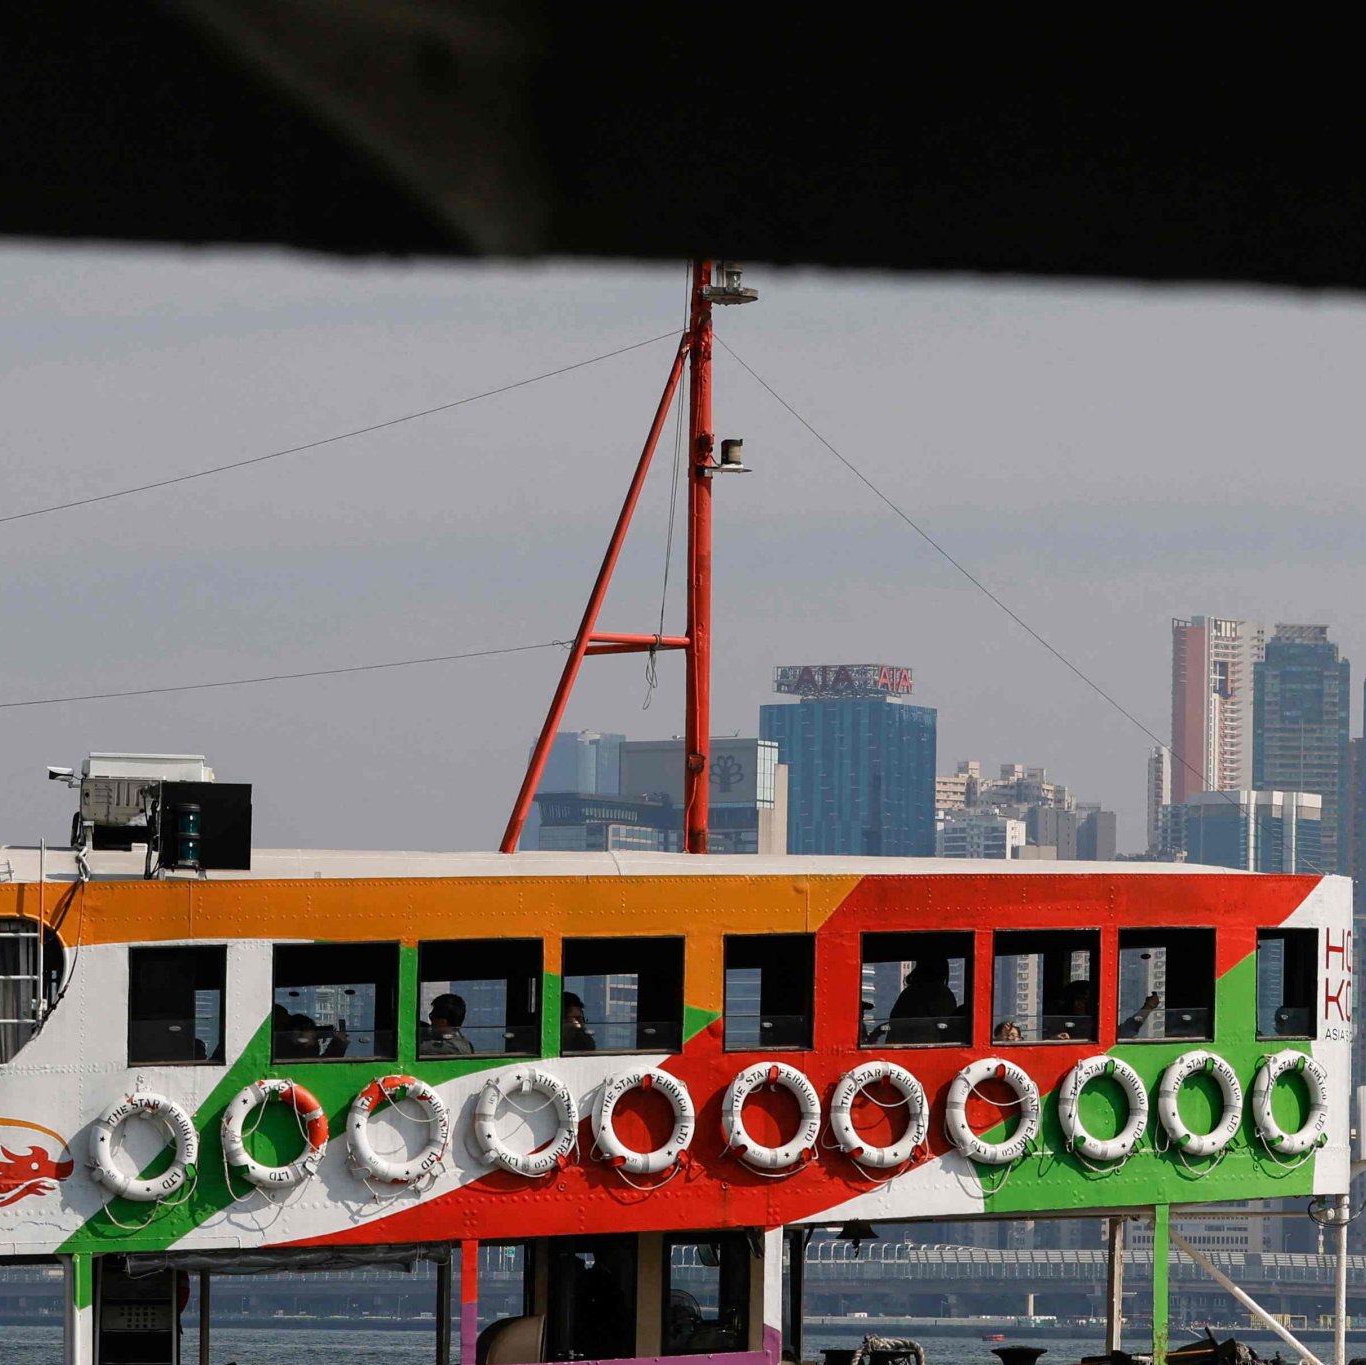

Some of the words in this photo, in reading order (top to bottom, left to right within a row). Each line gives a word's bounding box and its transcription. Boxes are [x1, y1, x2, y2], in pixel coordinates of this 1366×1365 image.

[795, 665, 855, 690] AIA
[878, 665, 912, 694] AIA
[538, 1074, 560, 1092] THE
[1006, 1067, 1027, 1085] THE
[841, 1083, 856, 1107] THE
[856, 1068, 882, 1084] STAR
[614, 1074, 641, 1092] STAR
[675, 1124, 689, 1145] LTD
[804, 1122, 817, 1142] LTD
[106, 1104, 129, 1126] THE
[131, 1098, 161, 1110] STAR
[162, 1171, 181, 1190] LTD
[421, 1151, 439, 1170] LTD
[269, 1171, 290, 1181] LTD
